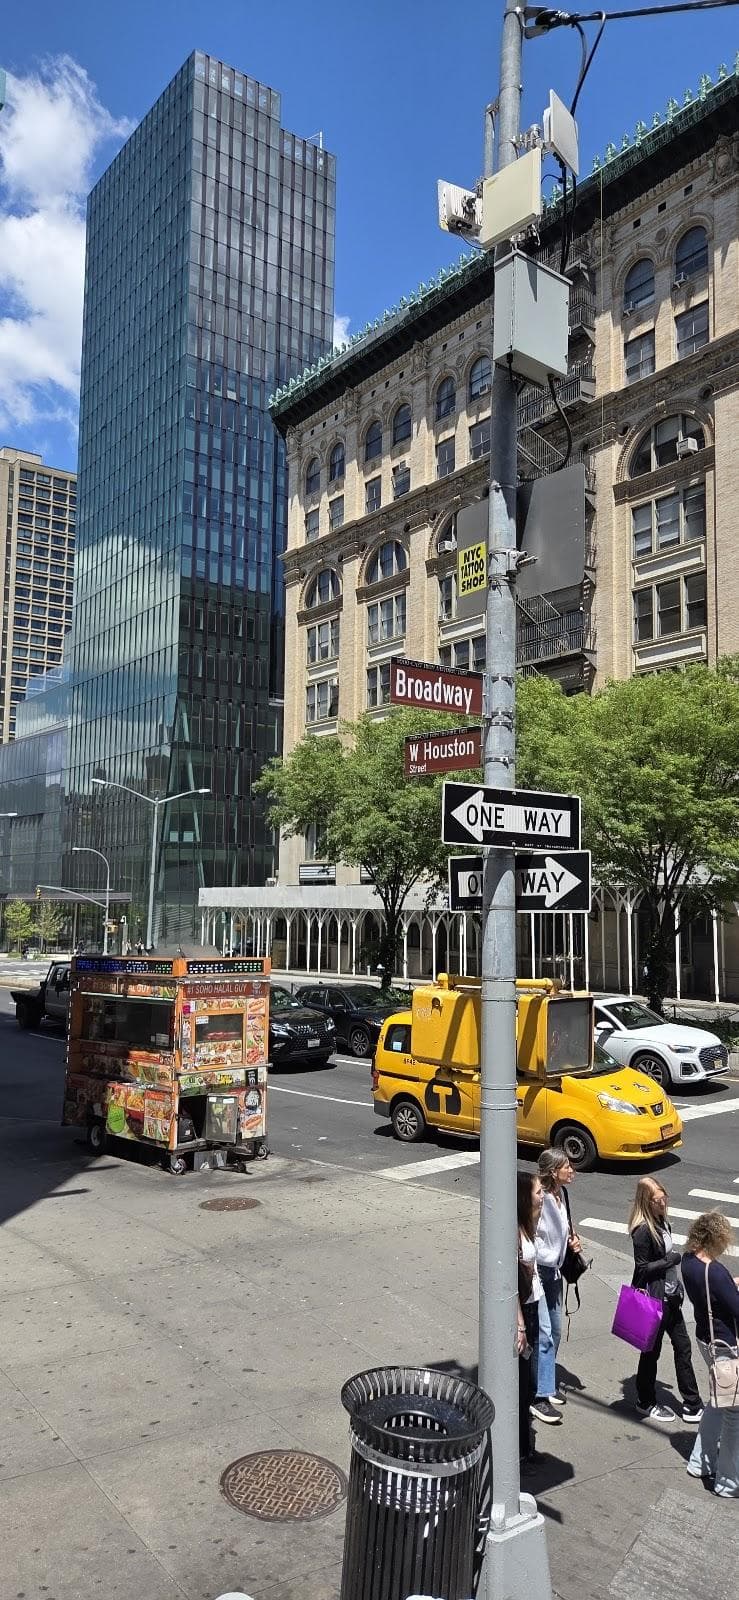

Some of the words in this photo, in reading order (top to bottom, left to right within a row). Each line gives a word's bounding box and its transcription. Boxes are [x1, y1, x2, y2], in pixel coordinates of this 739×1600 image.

[464, 546, 481, 564] NYC
[461, 559, 484, 579] TATTOO
[462, 574, 484, 592] SHOP
[396, 669, 472, 714] Broadway
[410, 744, 418, 761] W
[424, 738, 474, 760] Houston
[410, 763, 426, 774] Street
[467, 804, 504, 828] ONE
[524, 810, 562, 833] WAY
[521, 872, 564, 893] WAY
[195, 984, 213, 994] SOHO
[214, 984, 232, 993] HALAL
[235, 984, 247, 993] GUY
[433, 1085, 452, 1114] T
